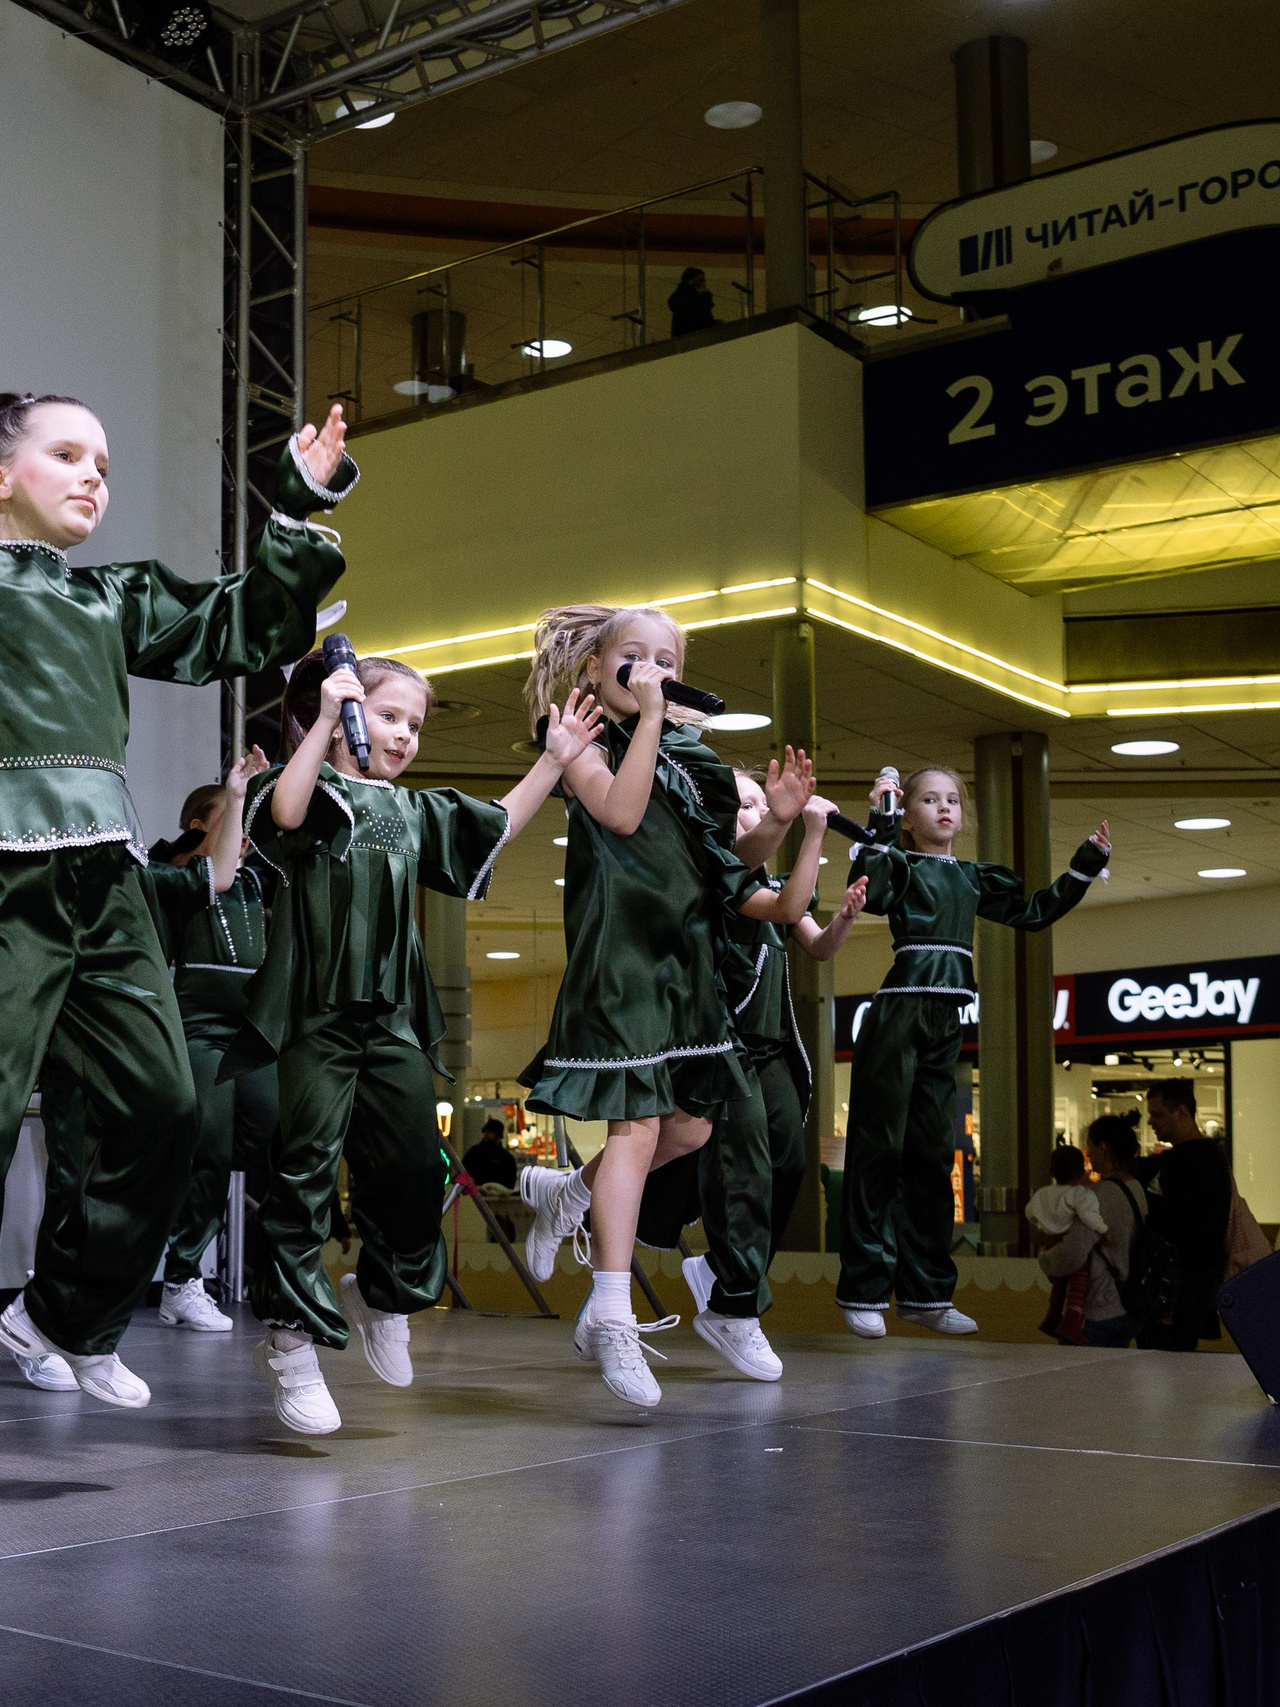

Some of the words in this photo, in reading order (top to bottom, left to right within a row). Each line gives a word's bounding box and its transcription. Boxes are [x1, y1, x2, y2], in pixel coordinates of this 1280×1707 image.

[945, 375, 996, 445] 2
[1024, 333, 1246, 427] этаж
[1107, 972, 1260, 1024] GeeJay
